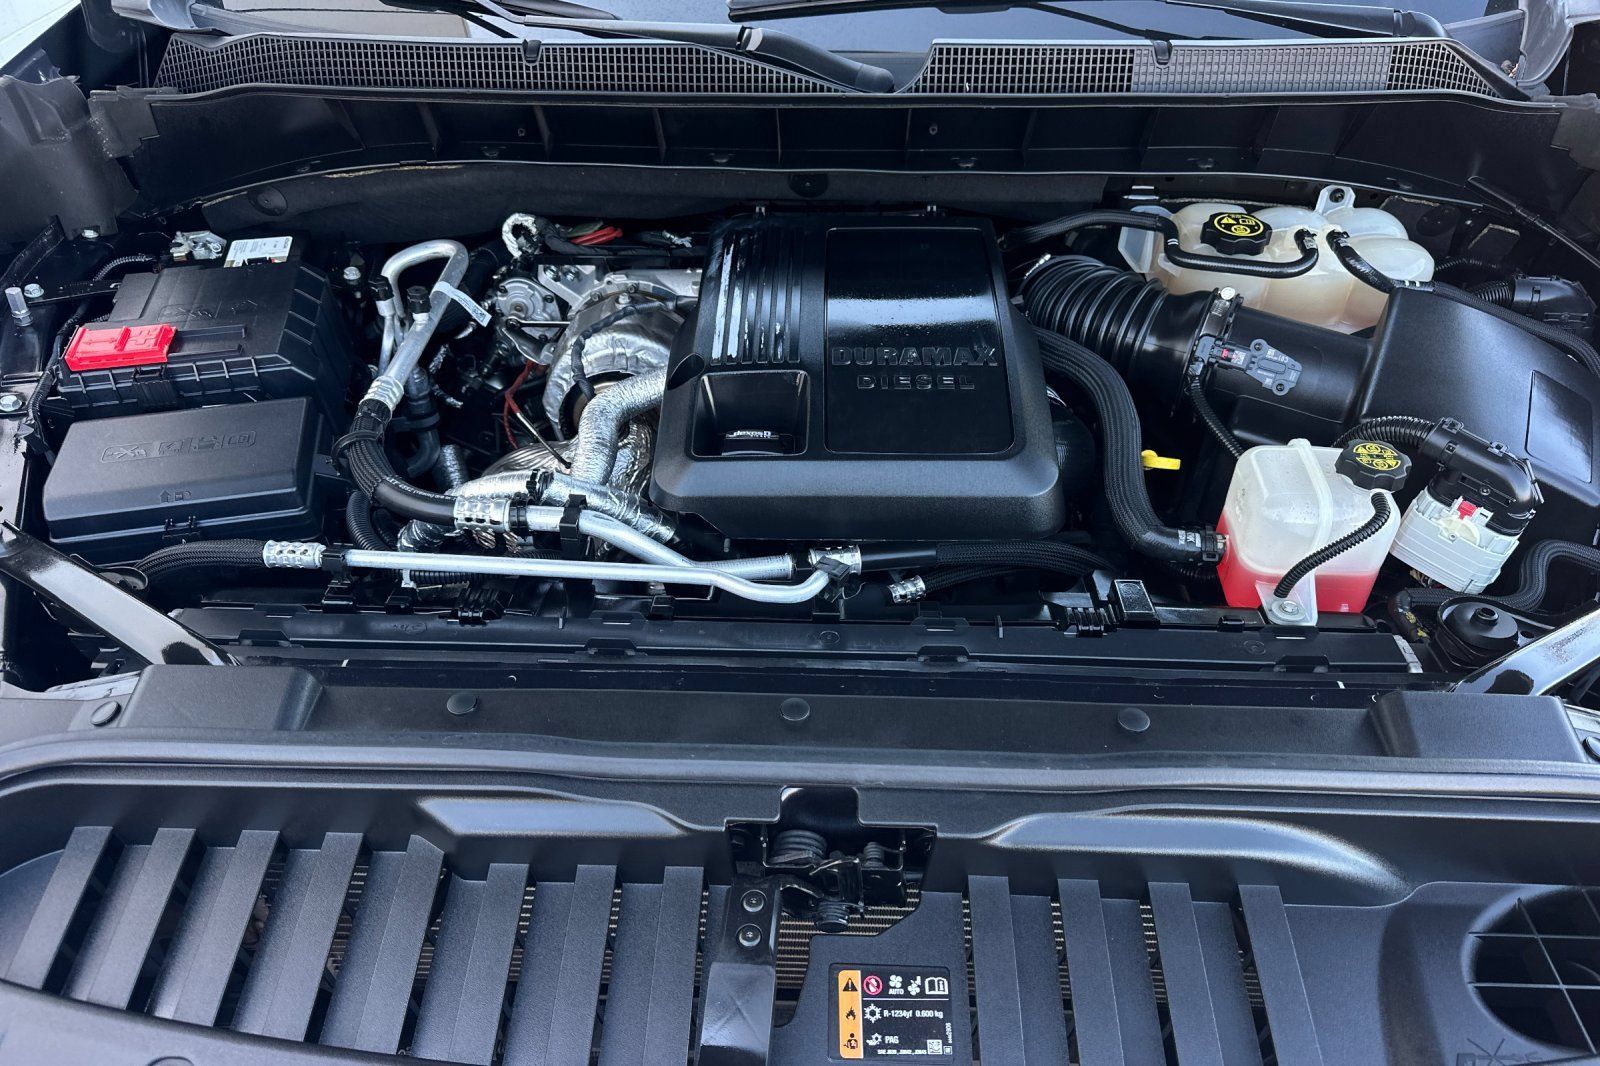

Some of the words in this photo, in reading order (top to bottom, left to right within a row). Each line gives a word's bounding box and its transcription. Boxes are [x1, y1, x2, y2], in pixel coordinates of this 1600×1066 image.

[831, 346, 998, 366] DURAMAX
[856, 374, 975, 390] DIESEL
[883, 1009, 913, 1019] R-1234yf
[934, 1009, 944, 1019] kg
[884, 1035, 899, 1044] PAG
